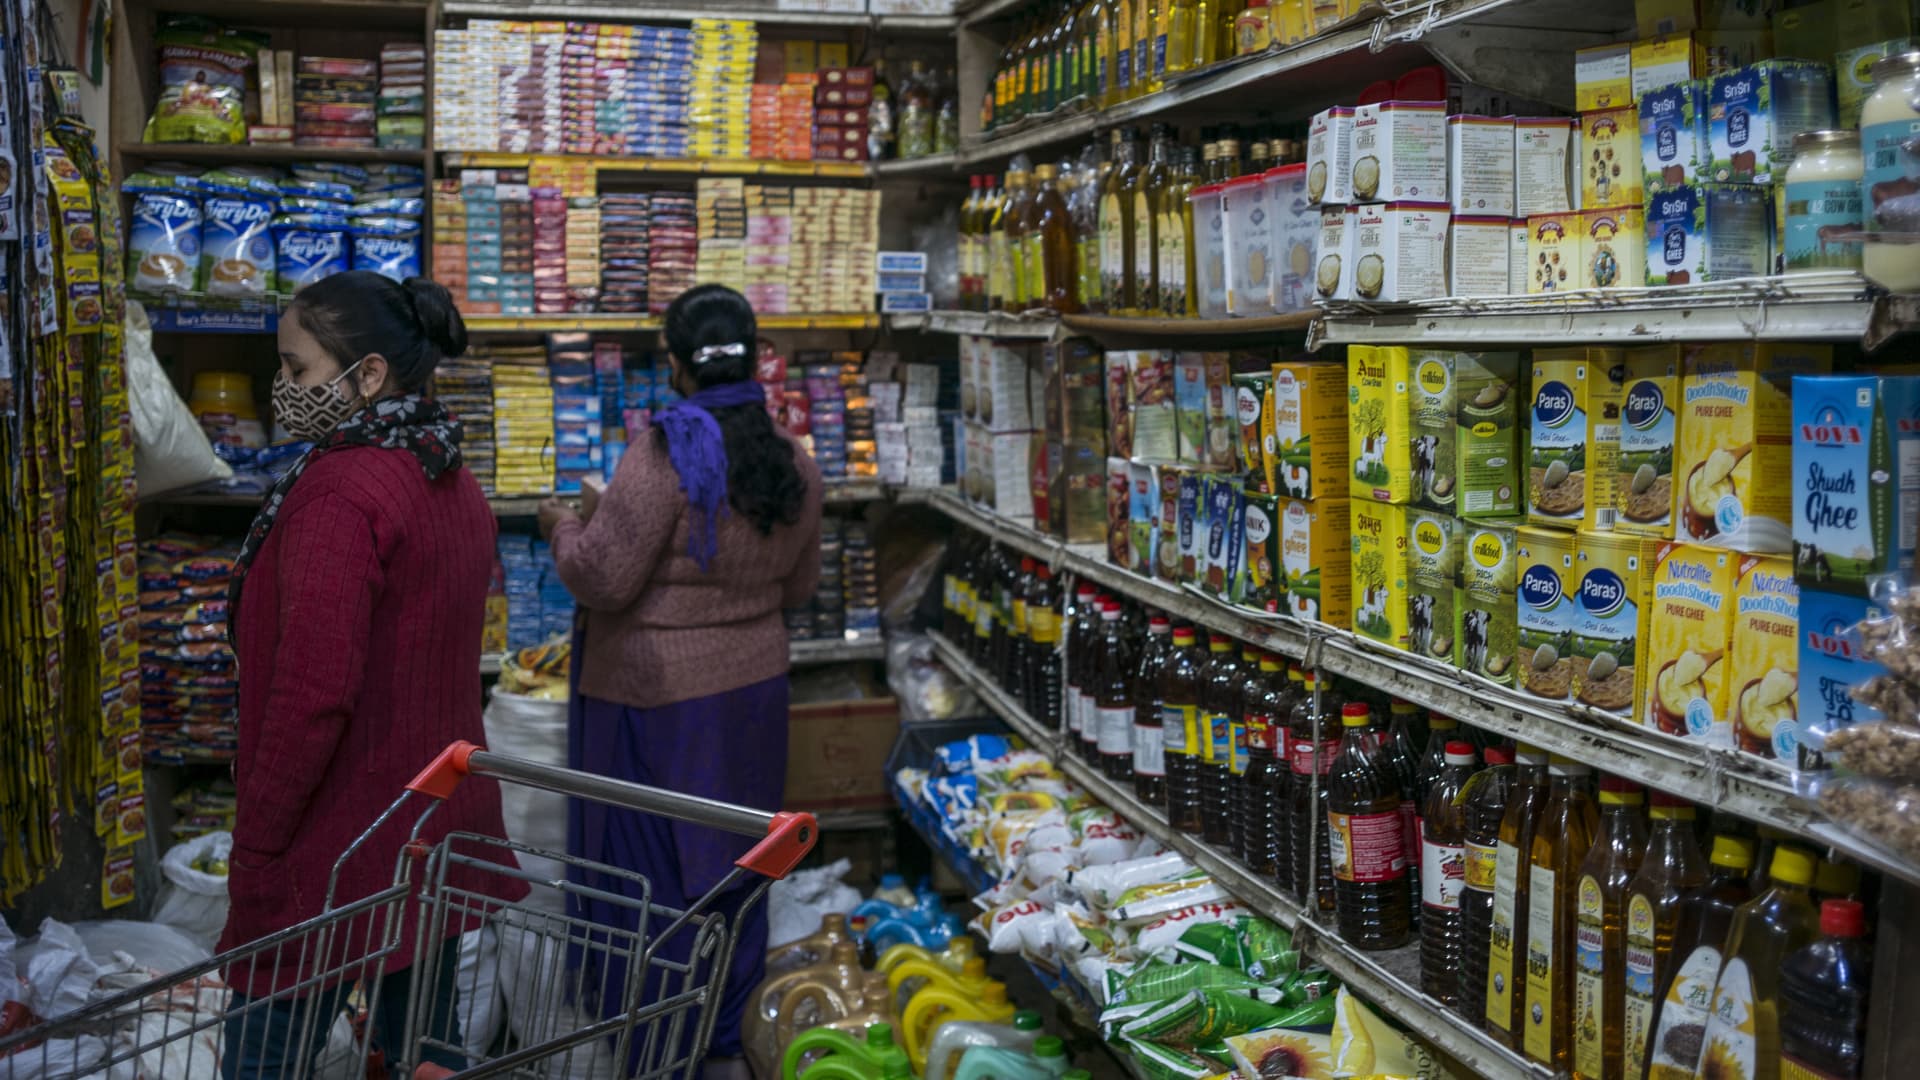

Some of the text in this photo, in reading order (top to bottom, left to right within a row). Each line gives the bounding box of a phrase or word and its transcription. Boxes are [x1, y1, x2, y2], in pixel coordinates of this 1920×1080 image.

[1357, 359, 1386, 379] Amul
[1538, 392, 1566, 410] Paras
[1628, 393, 1656, 411] Paras
[1695, 405, 1733, 418] PURE GHEE
[1801, 424, 1862, 443] NOVA
[1806, 461, 1856, 494] Shudh
[1806, 491, 1858, 533] Ghee
[1667, 559, 1713, 584] Nutralite
[1525, 573, 1555, 595] Paras
[1584, 577, 1617, 600] Paras
[1665, 602, 1705, 622] PURE GHEE
[1750, 618, 1794, 638] PURE GHEE
